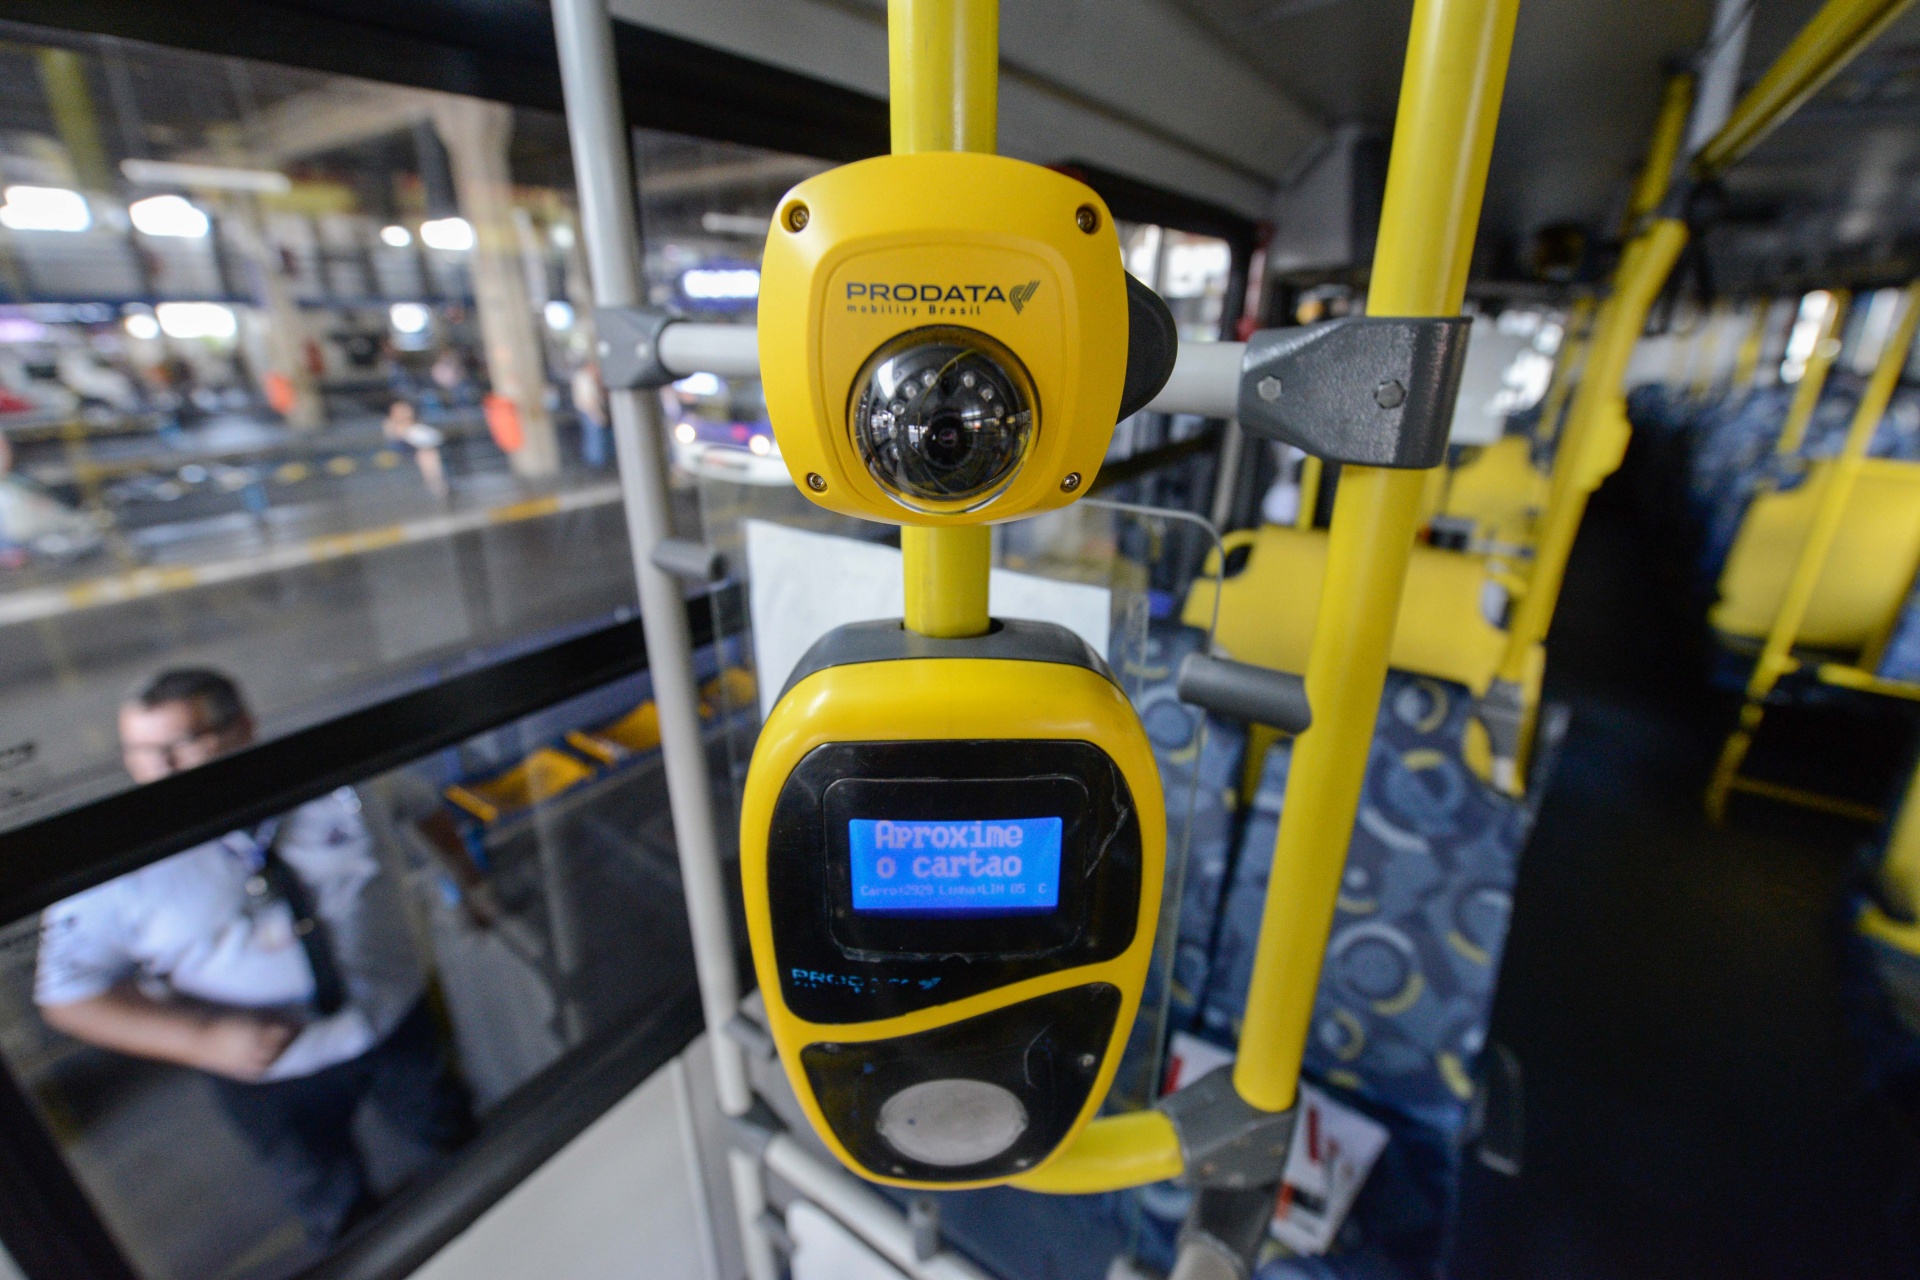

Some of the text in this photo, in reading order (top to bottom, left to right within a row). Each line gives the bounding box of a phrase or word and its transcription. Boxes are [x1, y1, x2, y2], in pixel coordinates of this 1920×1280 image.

[846, 282, 1006, 303] PRODATA
[846, 304, 981, 316] mobility Brasil
[874, 820, 1024, 849] Aproxime
[876, 850, 1023, 878] o cartao
